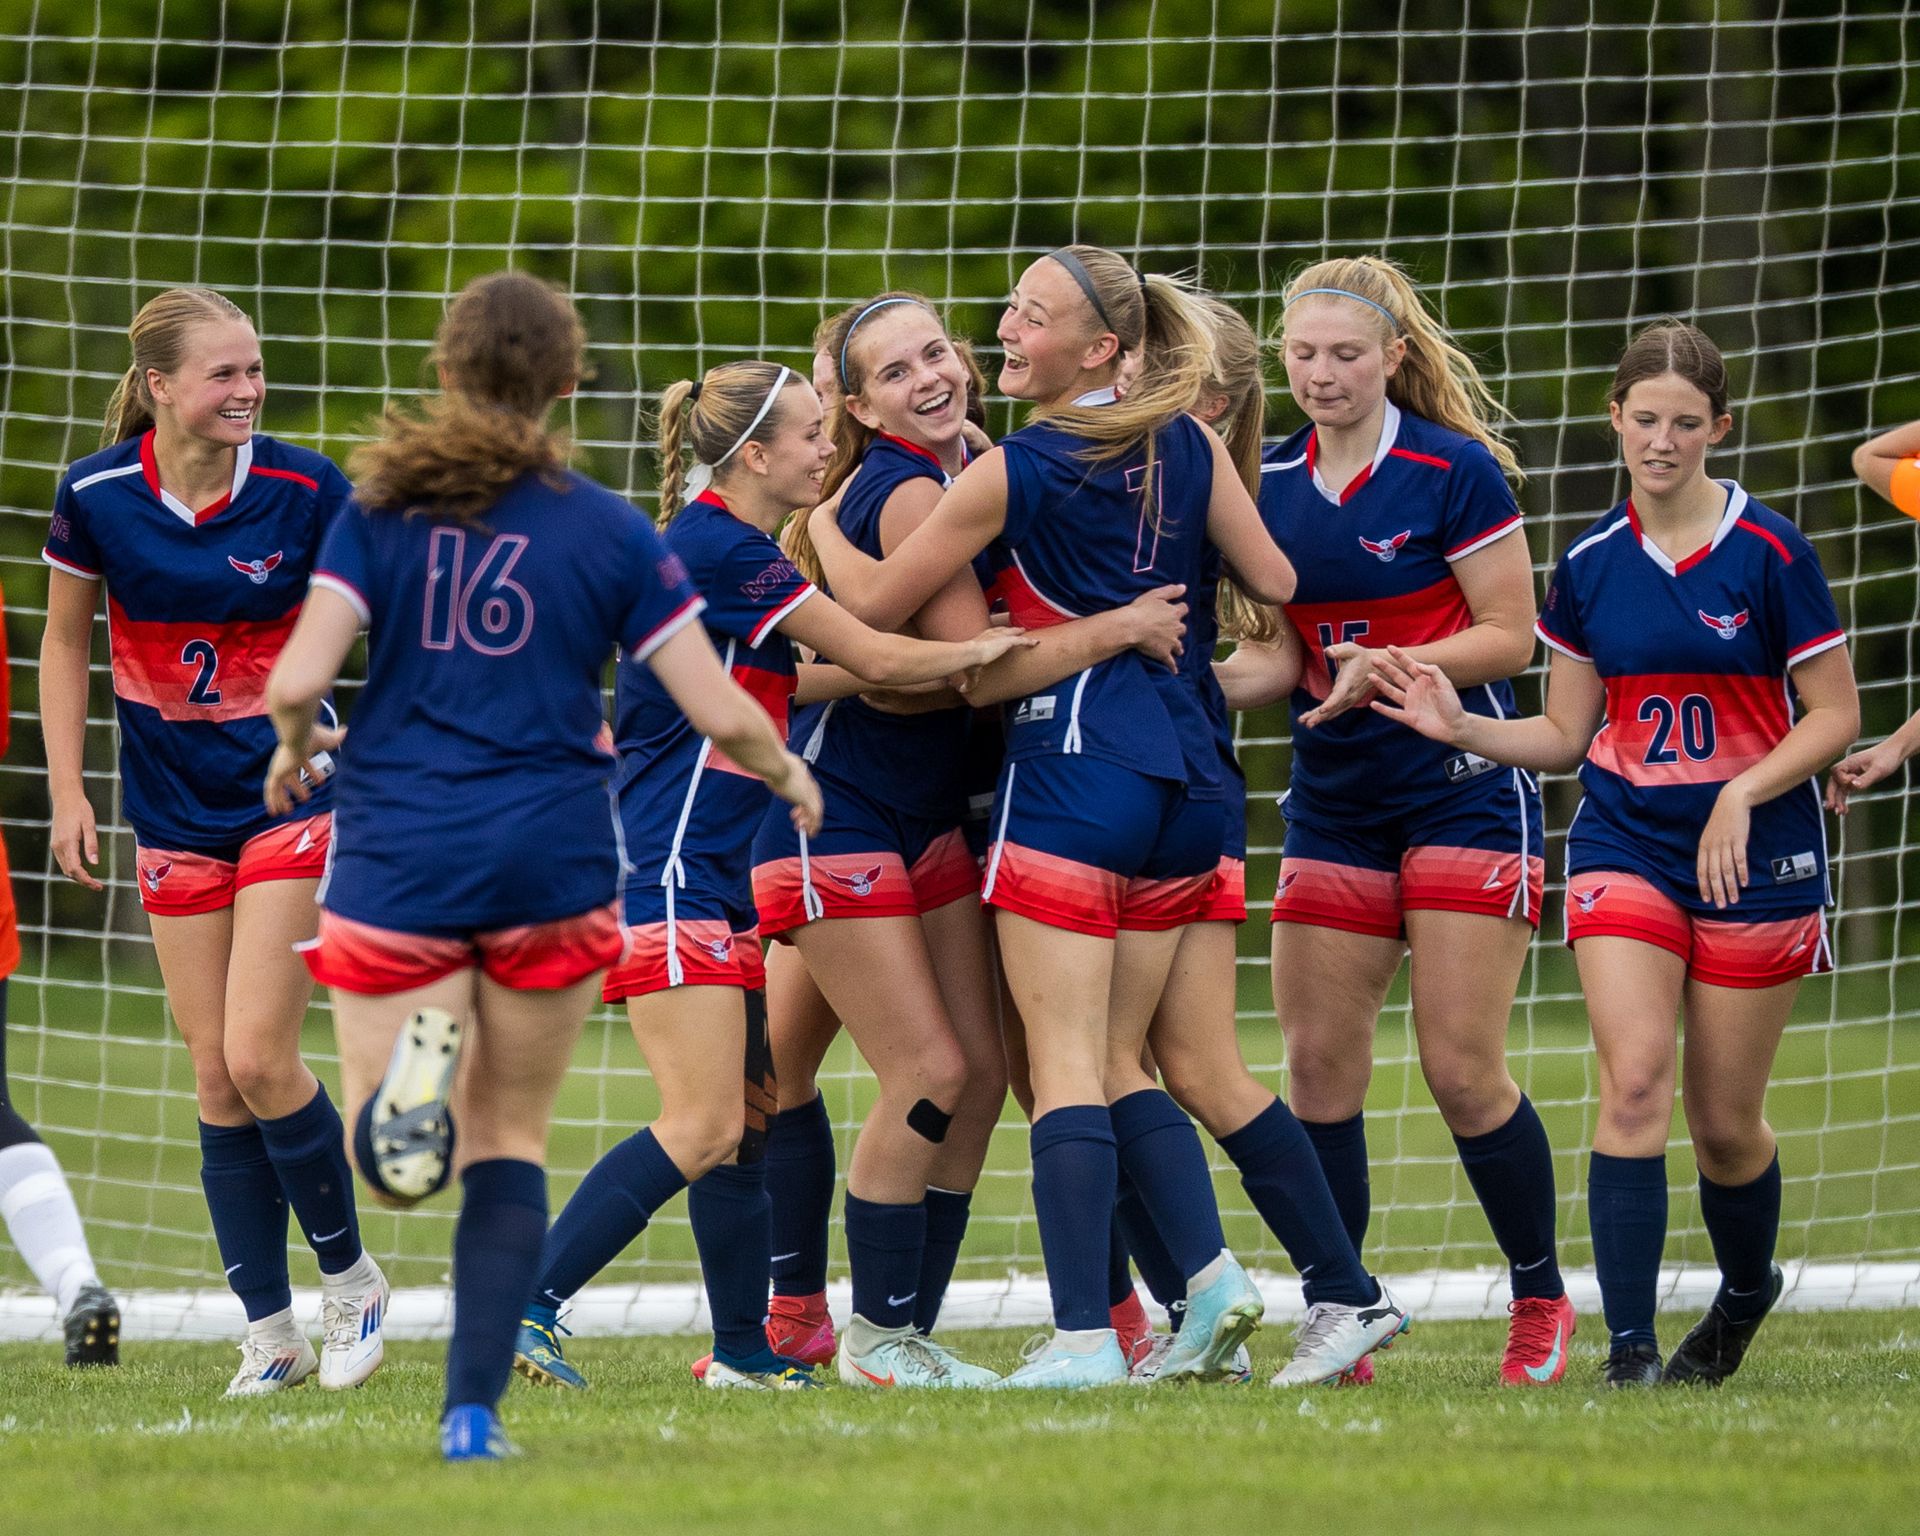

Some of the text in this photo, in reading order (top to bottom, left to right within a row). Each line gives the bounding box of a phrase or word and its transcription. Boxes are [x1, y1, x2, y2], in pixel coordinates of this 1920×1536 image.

[421, 526, 535, 656] 16
[181, 638, 223, 706] 2
[1637, 693, 1718, 767] 20
